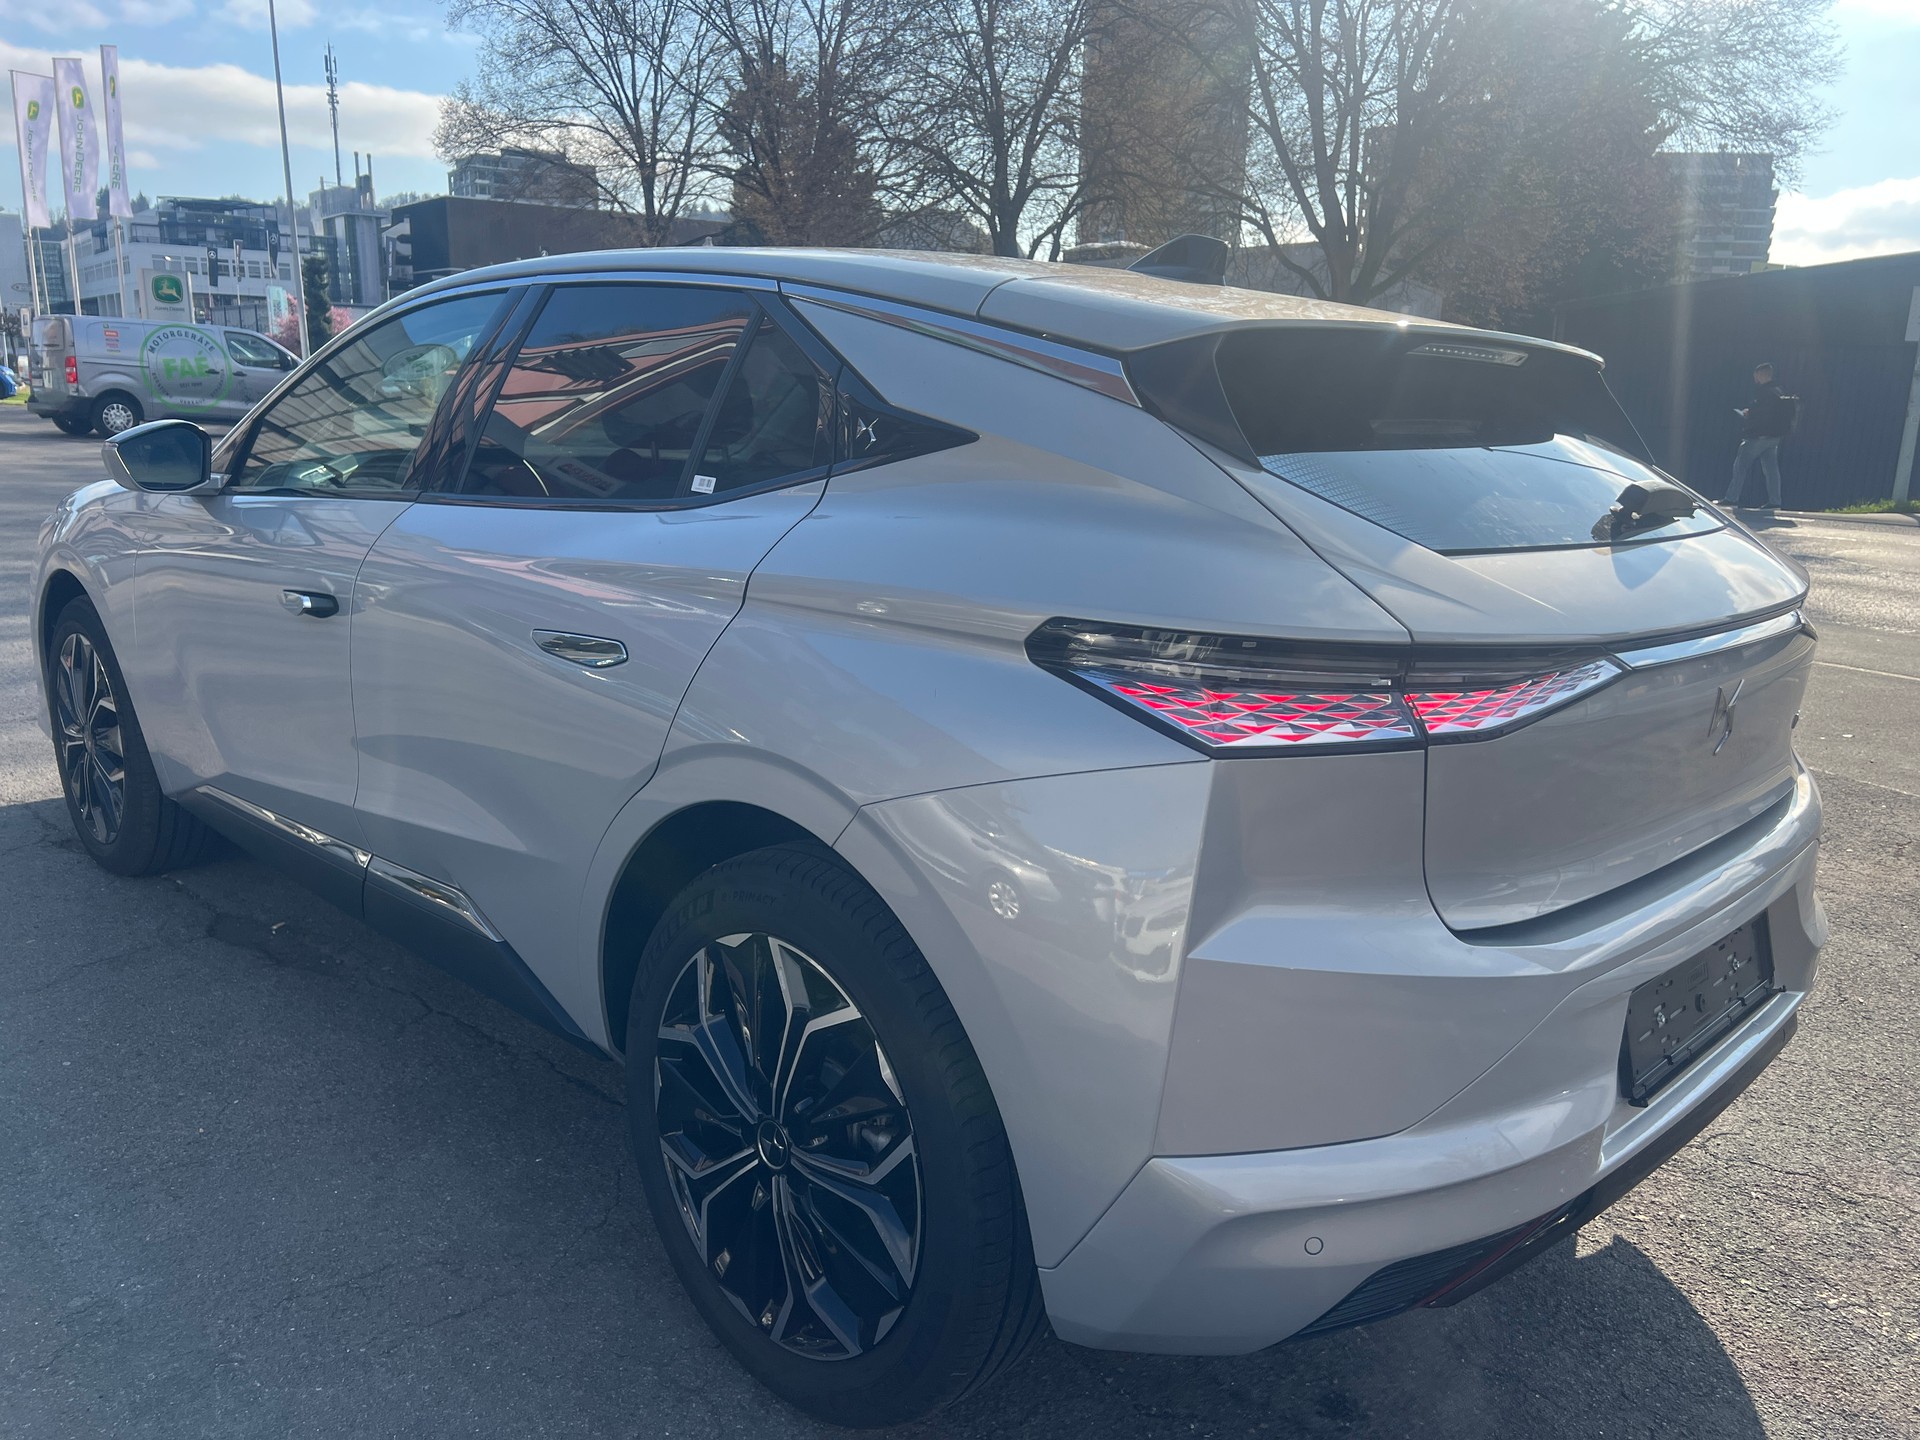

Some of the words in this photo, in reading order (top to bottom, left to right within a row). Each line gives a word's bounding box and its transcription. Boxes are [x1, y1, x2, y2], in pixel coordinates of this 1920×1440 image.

[27, 125, 35, 160] JOHN
[76, 114, 85, 152] JOHN
[73, 152, 85, 193] DEERE
[732, 889, 777, 906] PRIMACY
